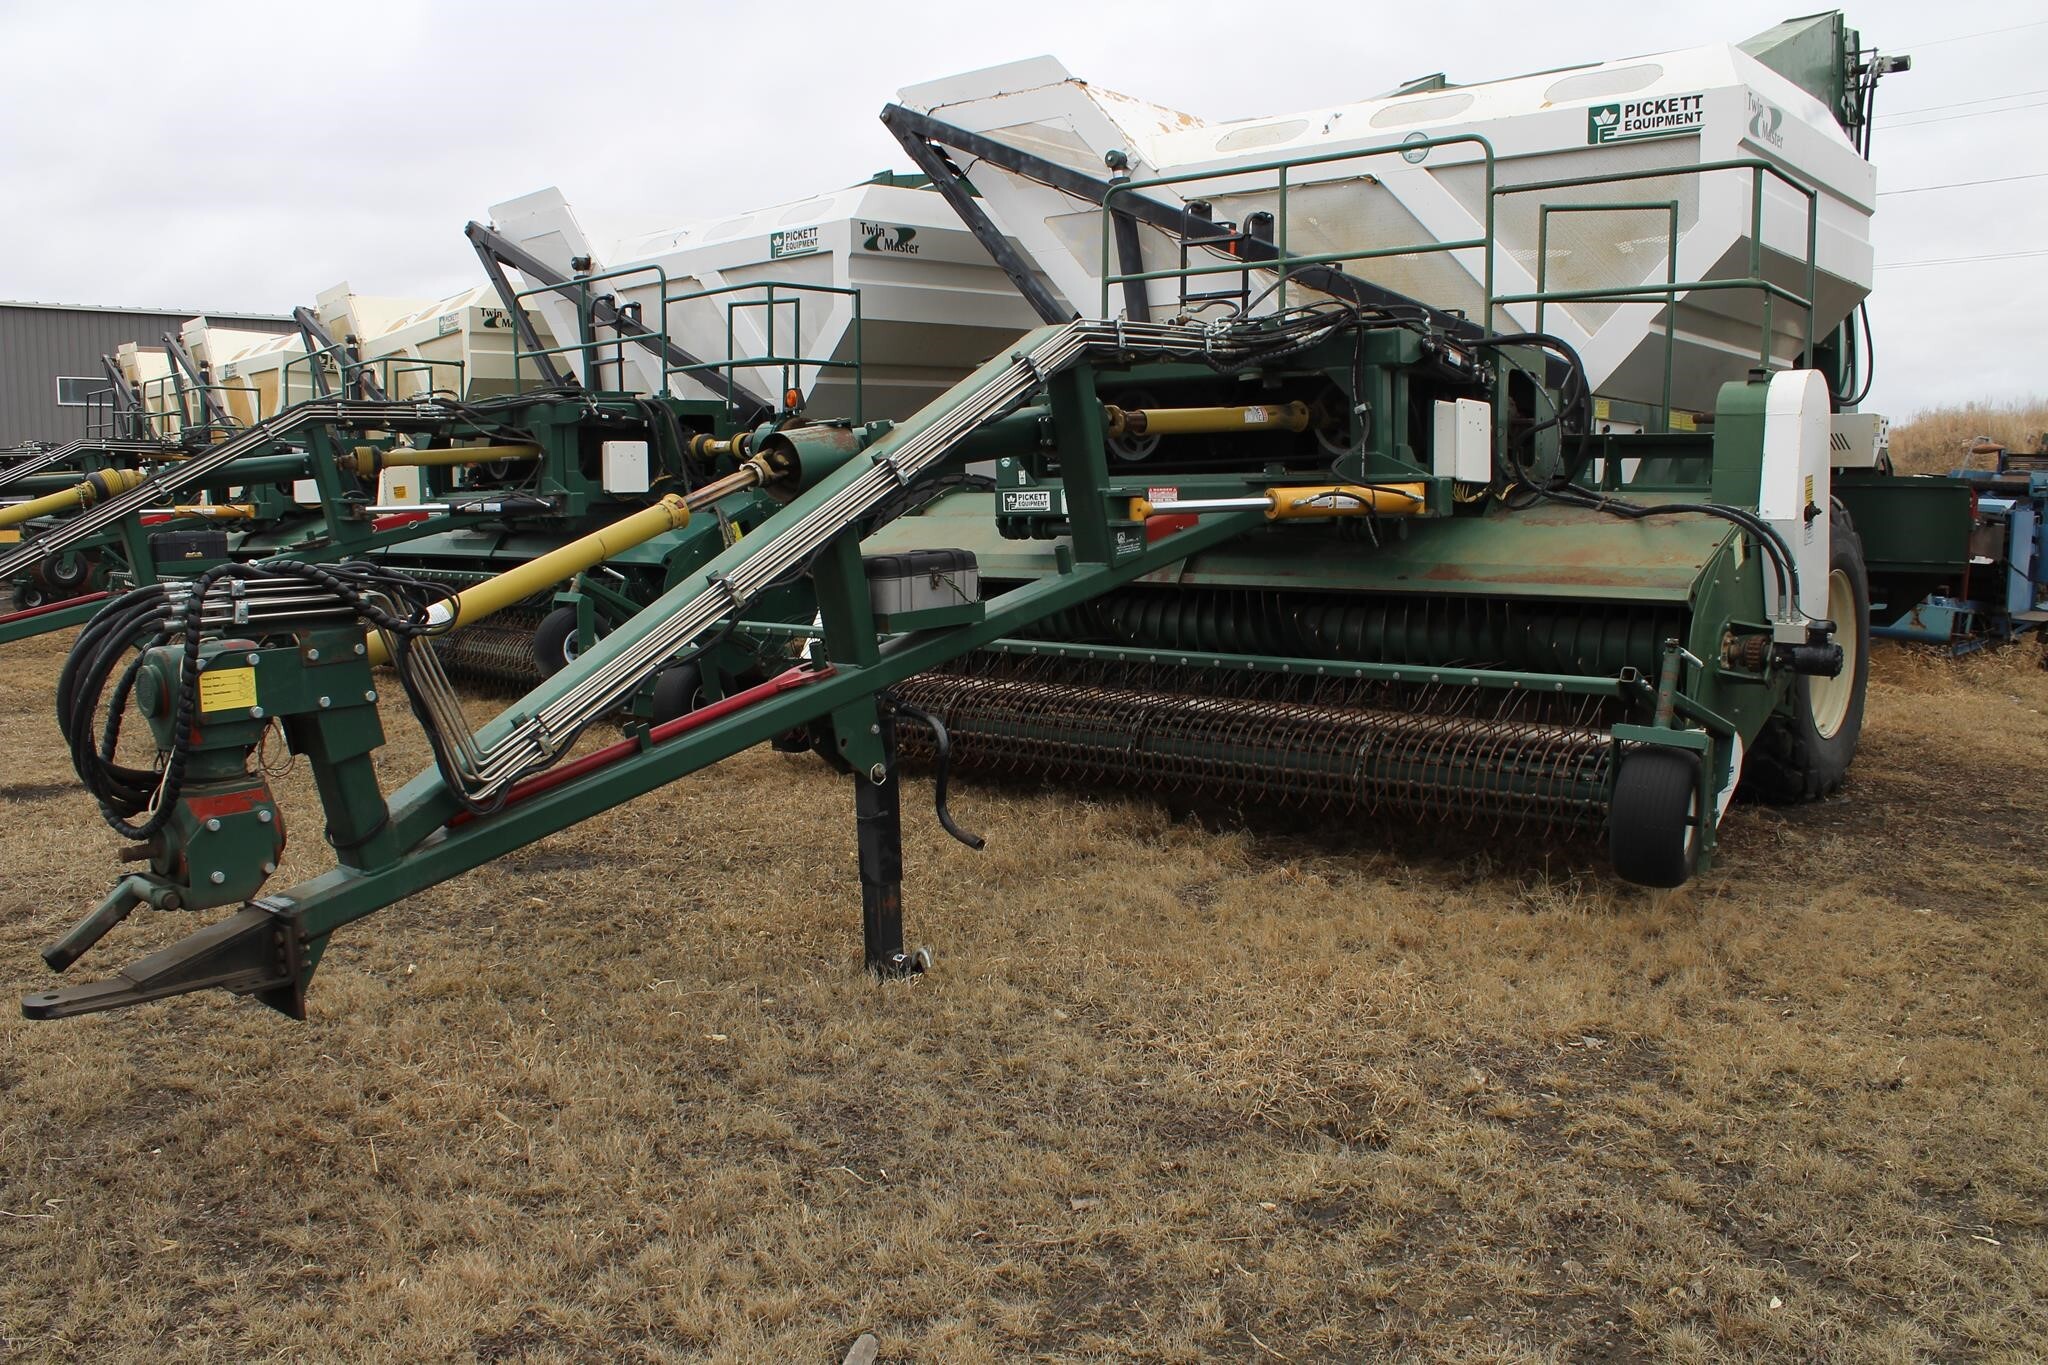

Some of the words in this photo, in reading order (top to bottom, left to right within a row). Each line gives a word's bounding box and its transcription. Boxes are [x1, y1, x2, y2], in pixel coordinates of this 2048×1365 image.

[1625, 94, 1704, 118] PICKETT
[1748, 91, 1764, 118] Twin
[1624, 111, 1704, 131] EQUIPMENT
[785, 227, 818, 242] PICKETT
[860, 222, 885, 237] Twin
[785, 238, 818, 251] EQUIPMENT
[884, 237, 920, 254] Master
[480, 307, 503, 318] Twin
[1018, 493, 1048, 501] PICKETT
